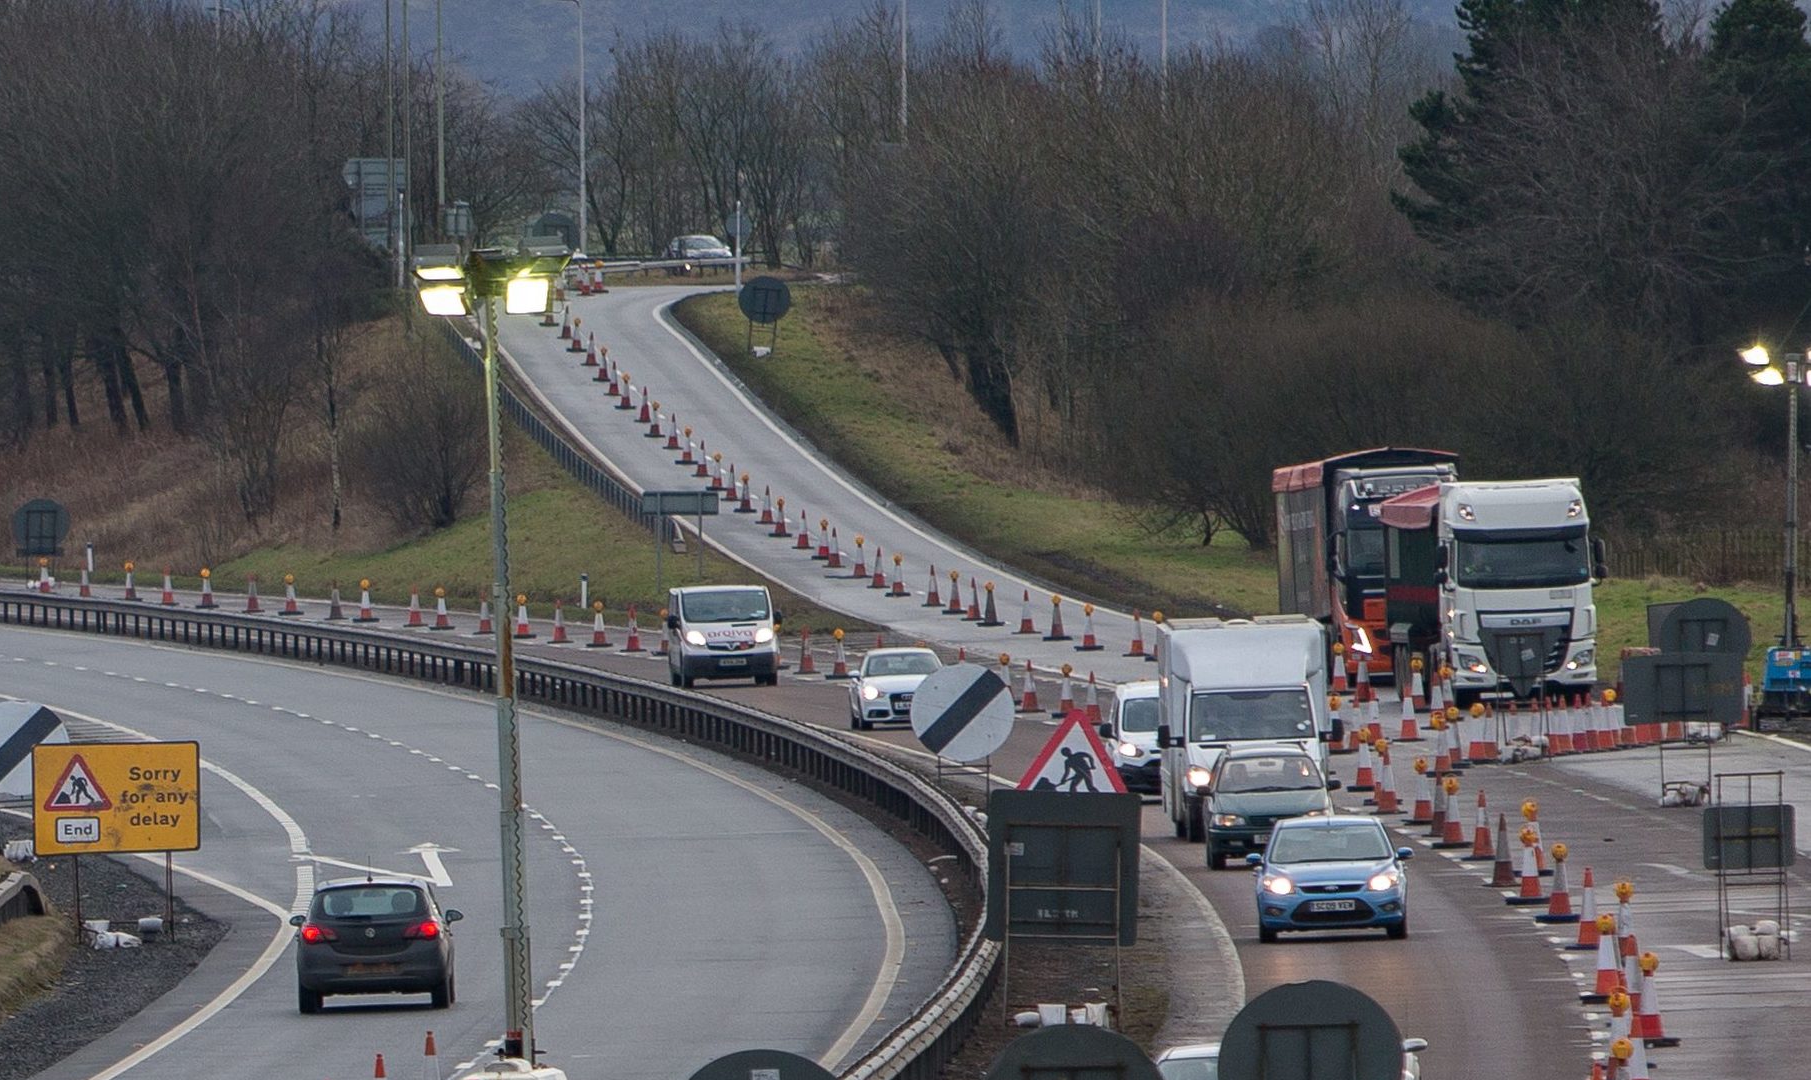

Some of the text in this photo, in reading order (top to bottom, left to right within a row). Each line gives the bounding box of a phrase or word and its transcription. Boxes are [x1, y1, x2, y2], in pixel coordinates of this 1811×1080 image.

[129, 766, 181, 783] Sorry
[121, 790, 189, 805] for any
[130, 813, 181, 828] delay
[64, 823, 93, 836] End
